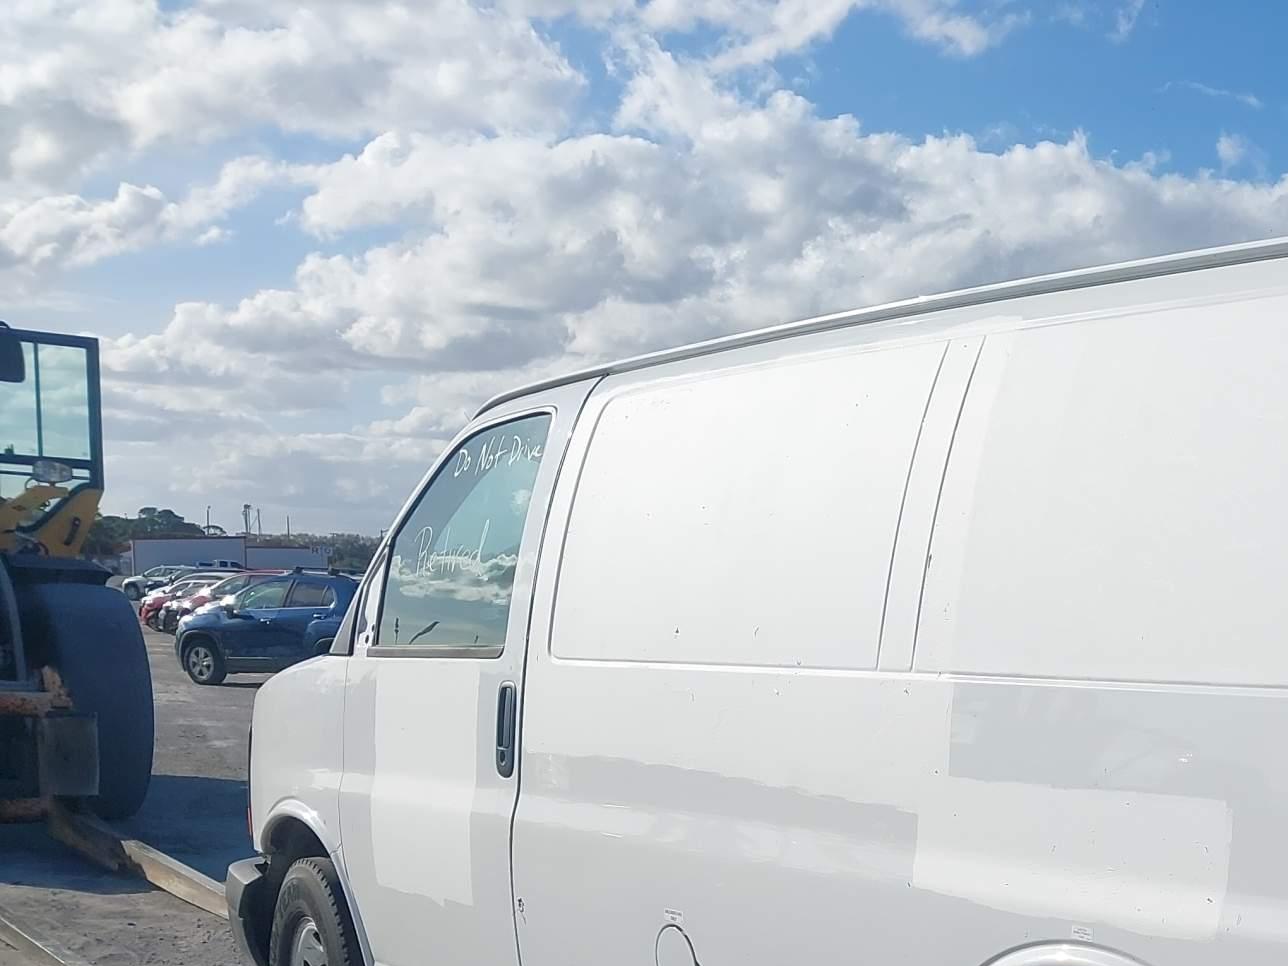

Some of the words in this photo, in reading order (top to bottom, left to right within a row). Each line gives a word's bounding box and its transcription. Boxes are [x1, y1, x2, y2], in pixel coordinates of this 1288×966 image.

[454, 449, 472, 477] Do
[475, 435, 507, 476] Not
[508, 435, 543, 467] Drive
[414, 519, 490, 577] Retired
